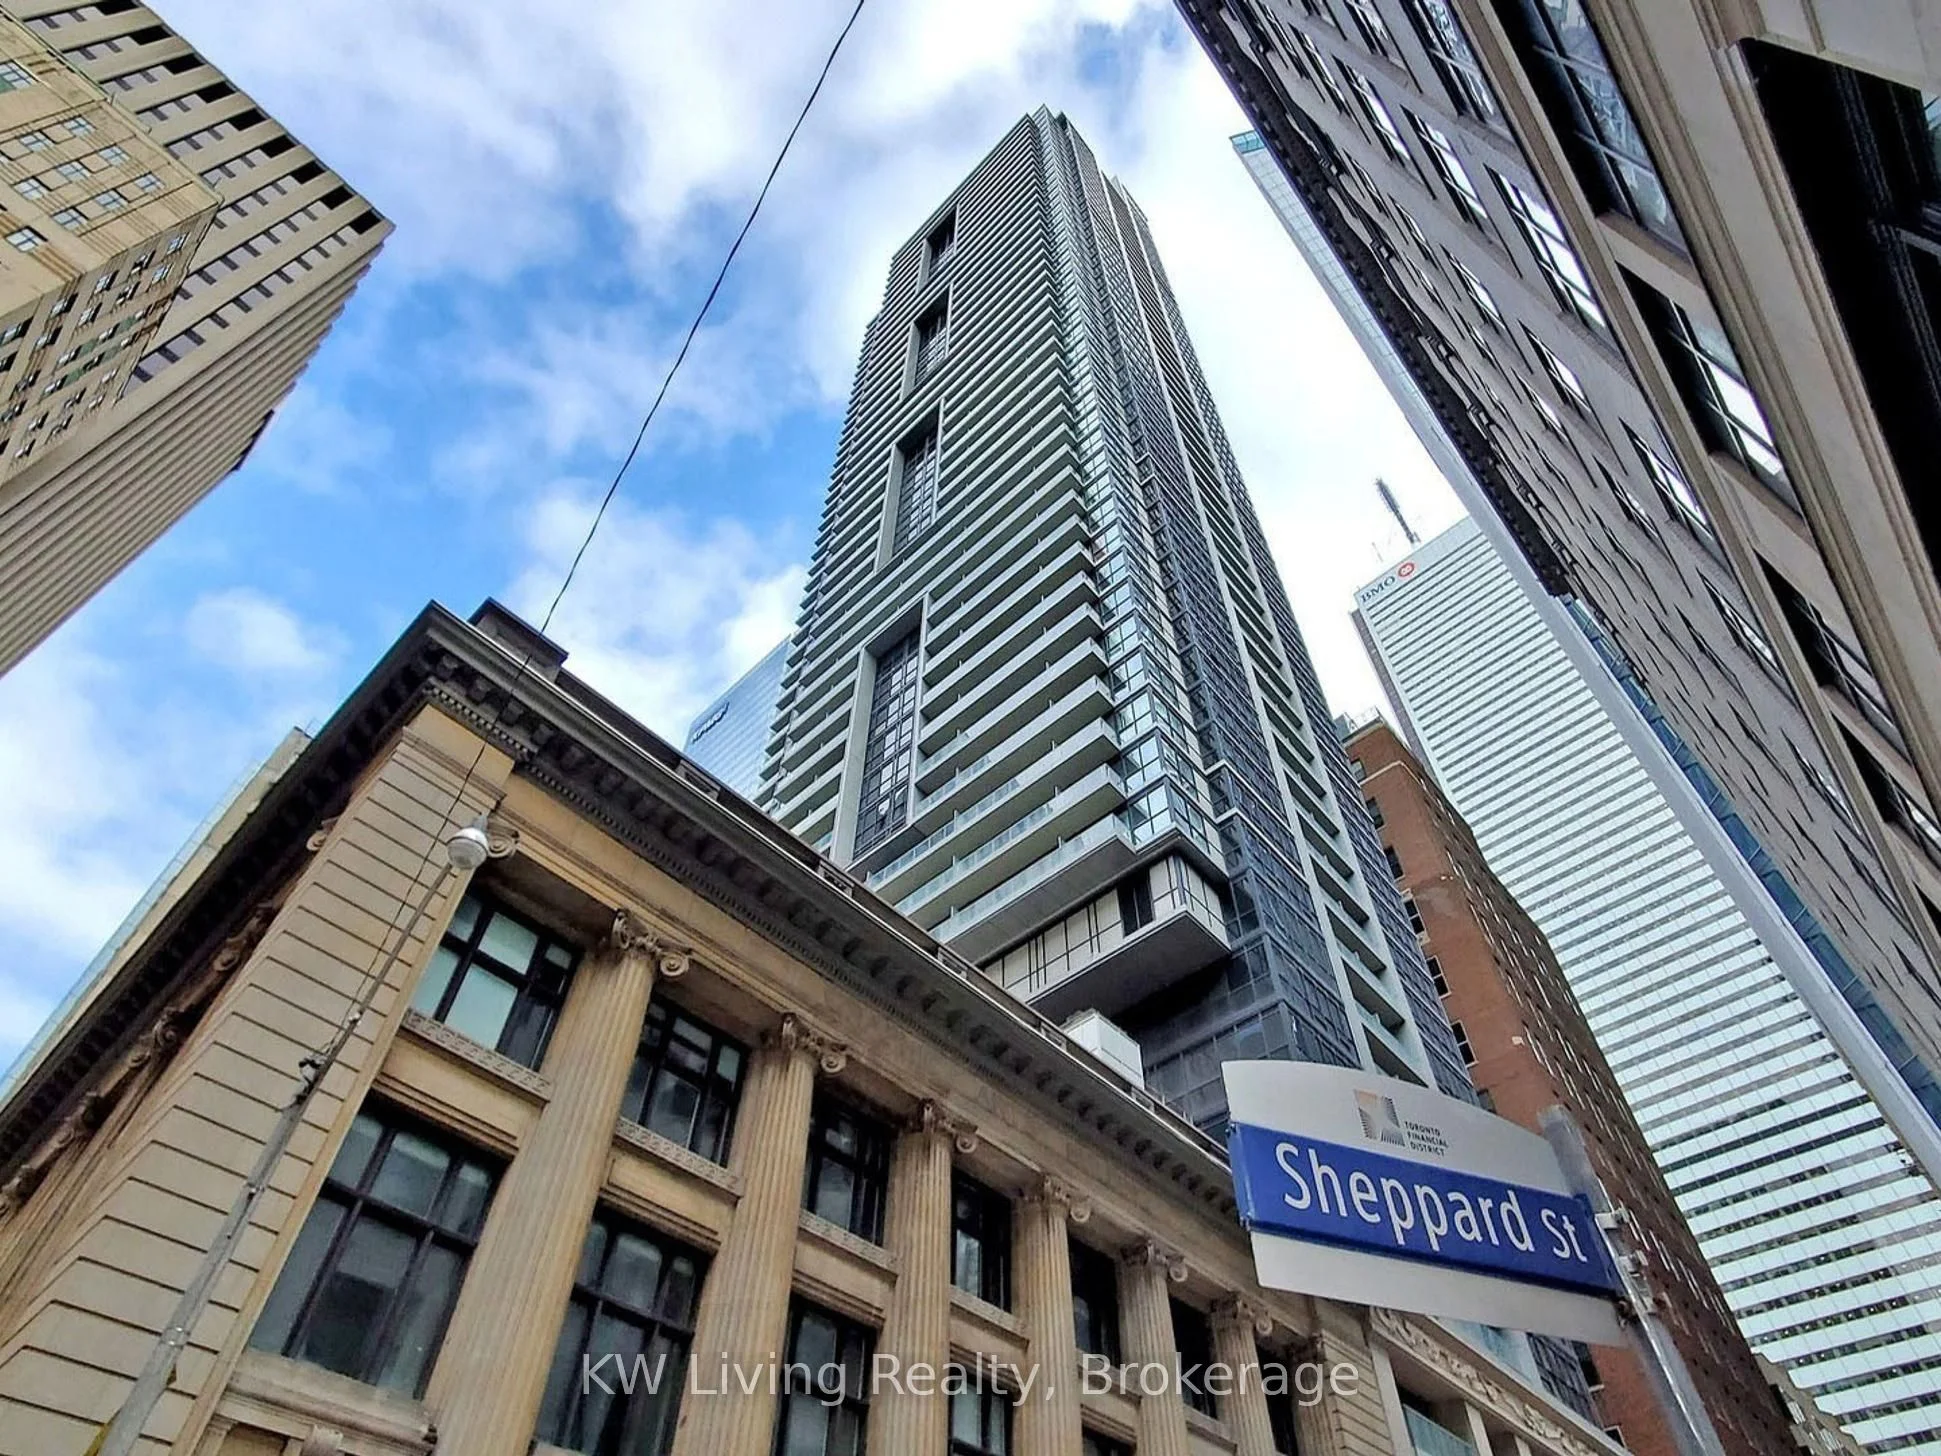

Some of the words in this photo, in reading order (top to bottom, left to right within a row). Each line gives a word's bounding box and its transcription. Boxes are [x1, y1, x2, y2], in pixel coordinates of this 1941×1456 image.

[1361, 576, 1396, 602] BMO
[1404, 1120, 1441, 1137] TORONTO
[1407, 1130, 1449, 1148] FINANCIAL
[1410, 1140, 1445, 1157] DISTRICT
[1275, 1142, 1535, 1252] Sheppard
[1541, 1207, 1588, 1264] St
